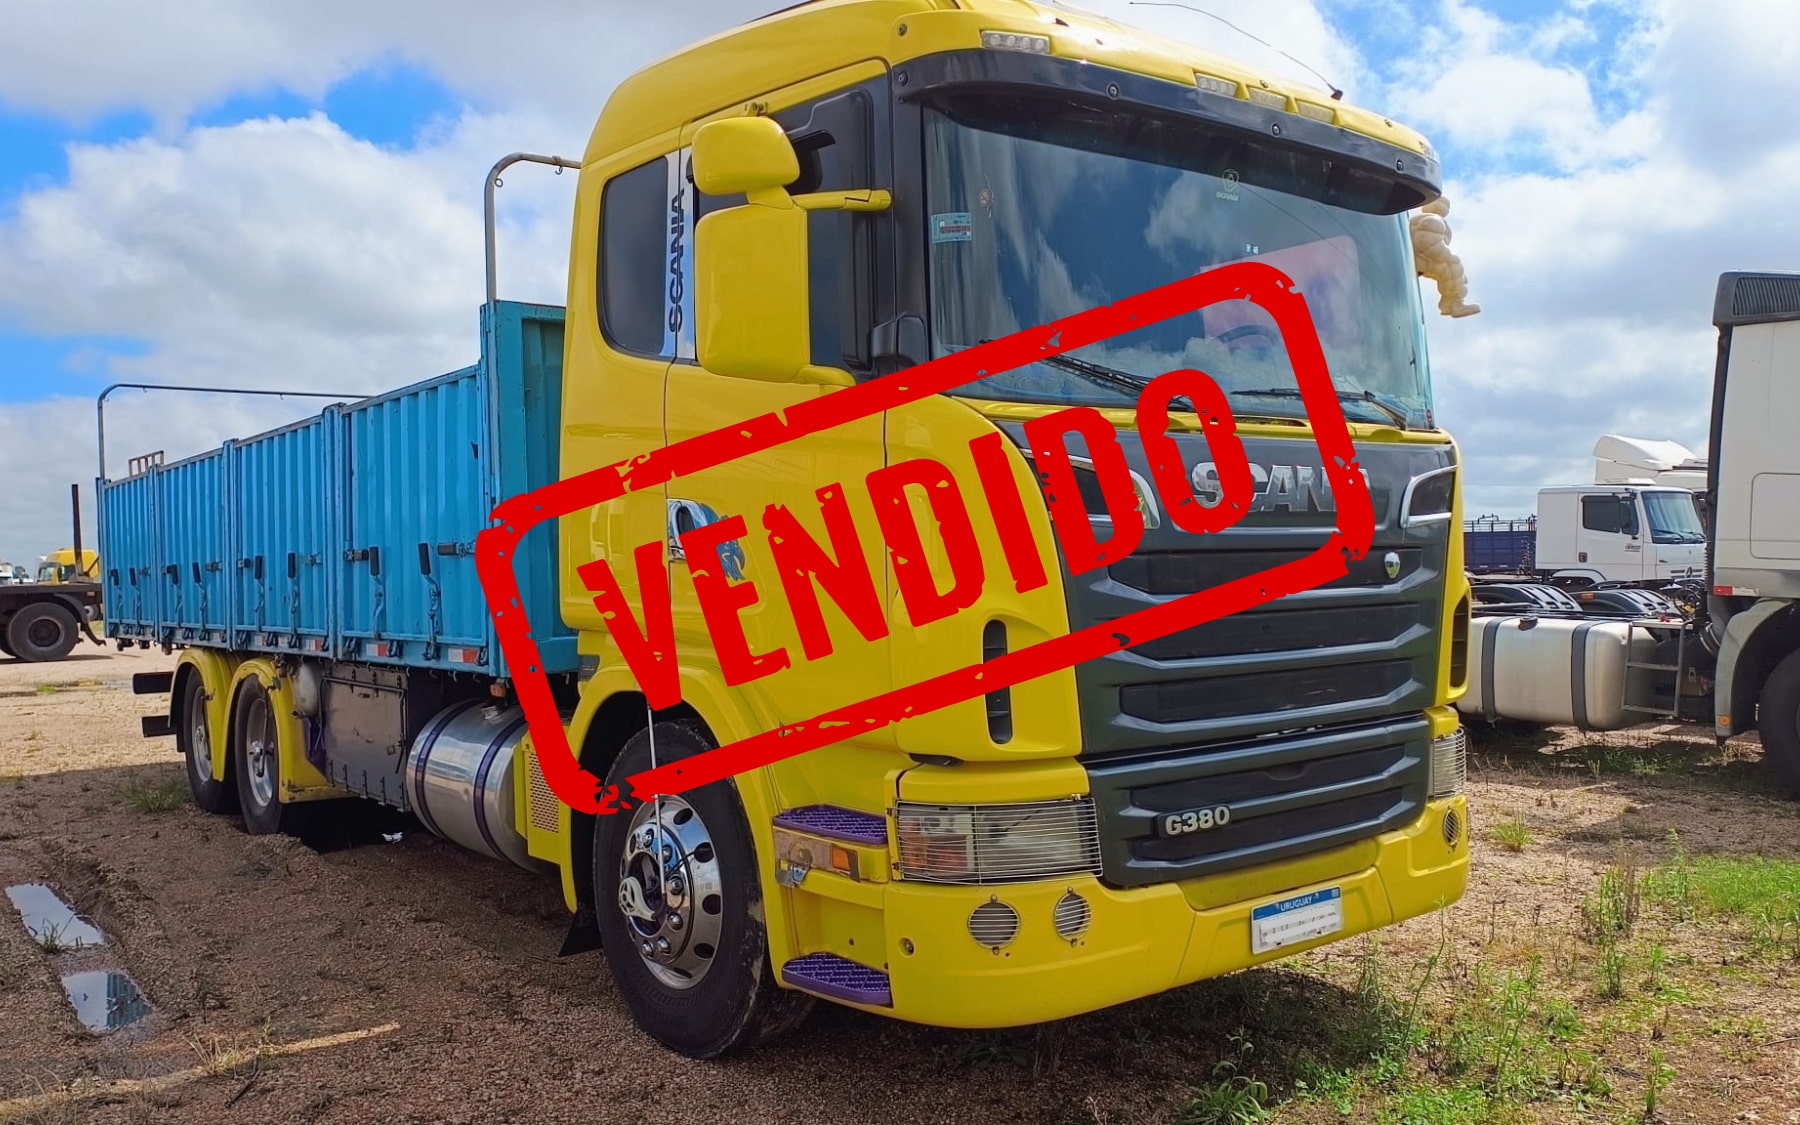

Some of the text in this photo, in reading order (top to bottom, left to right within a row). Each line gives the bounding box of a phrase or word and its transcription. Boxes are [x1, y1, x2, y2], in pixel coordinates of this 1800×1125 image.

[668, 187, 685, 333] SCANIA
[1191, 461, 1374, 512] SAN
[1165, 806, 1230, 835] G380
[1280, 895, 1313, 912] URUGUAY
